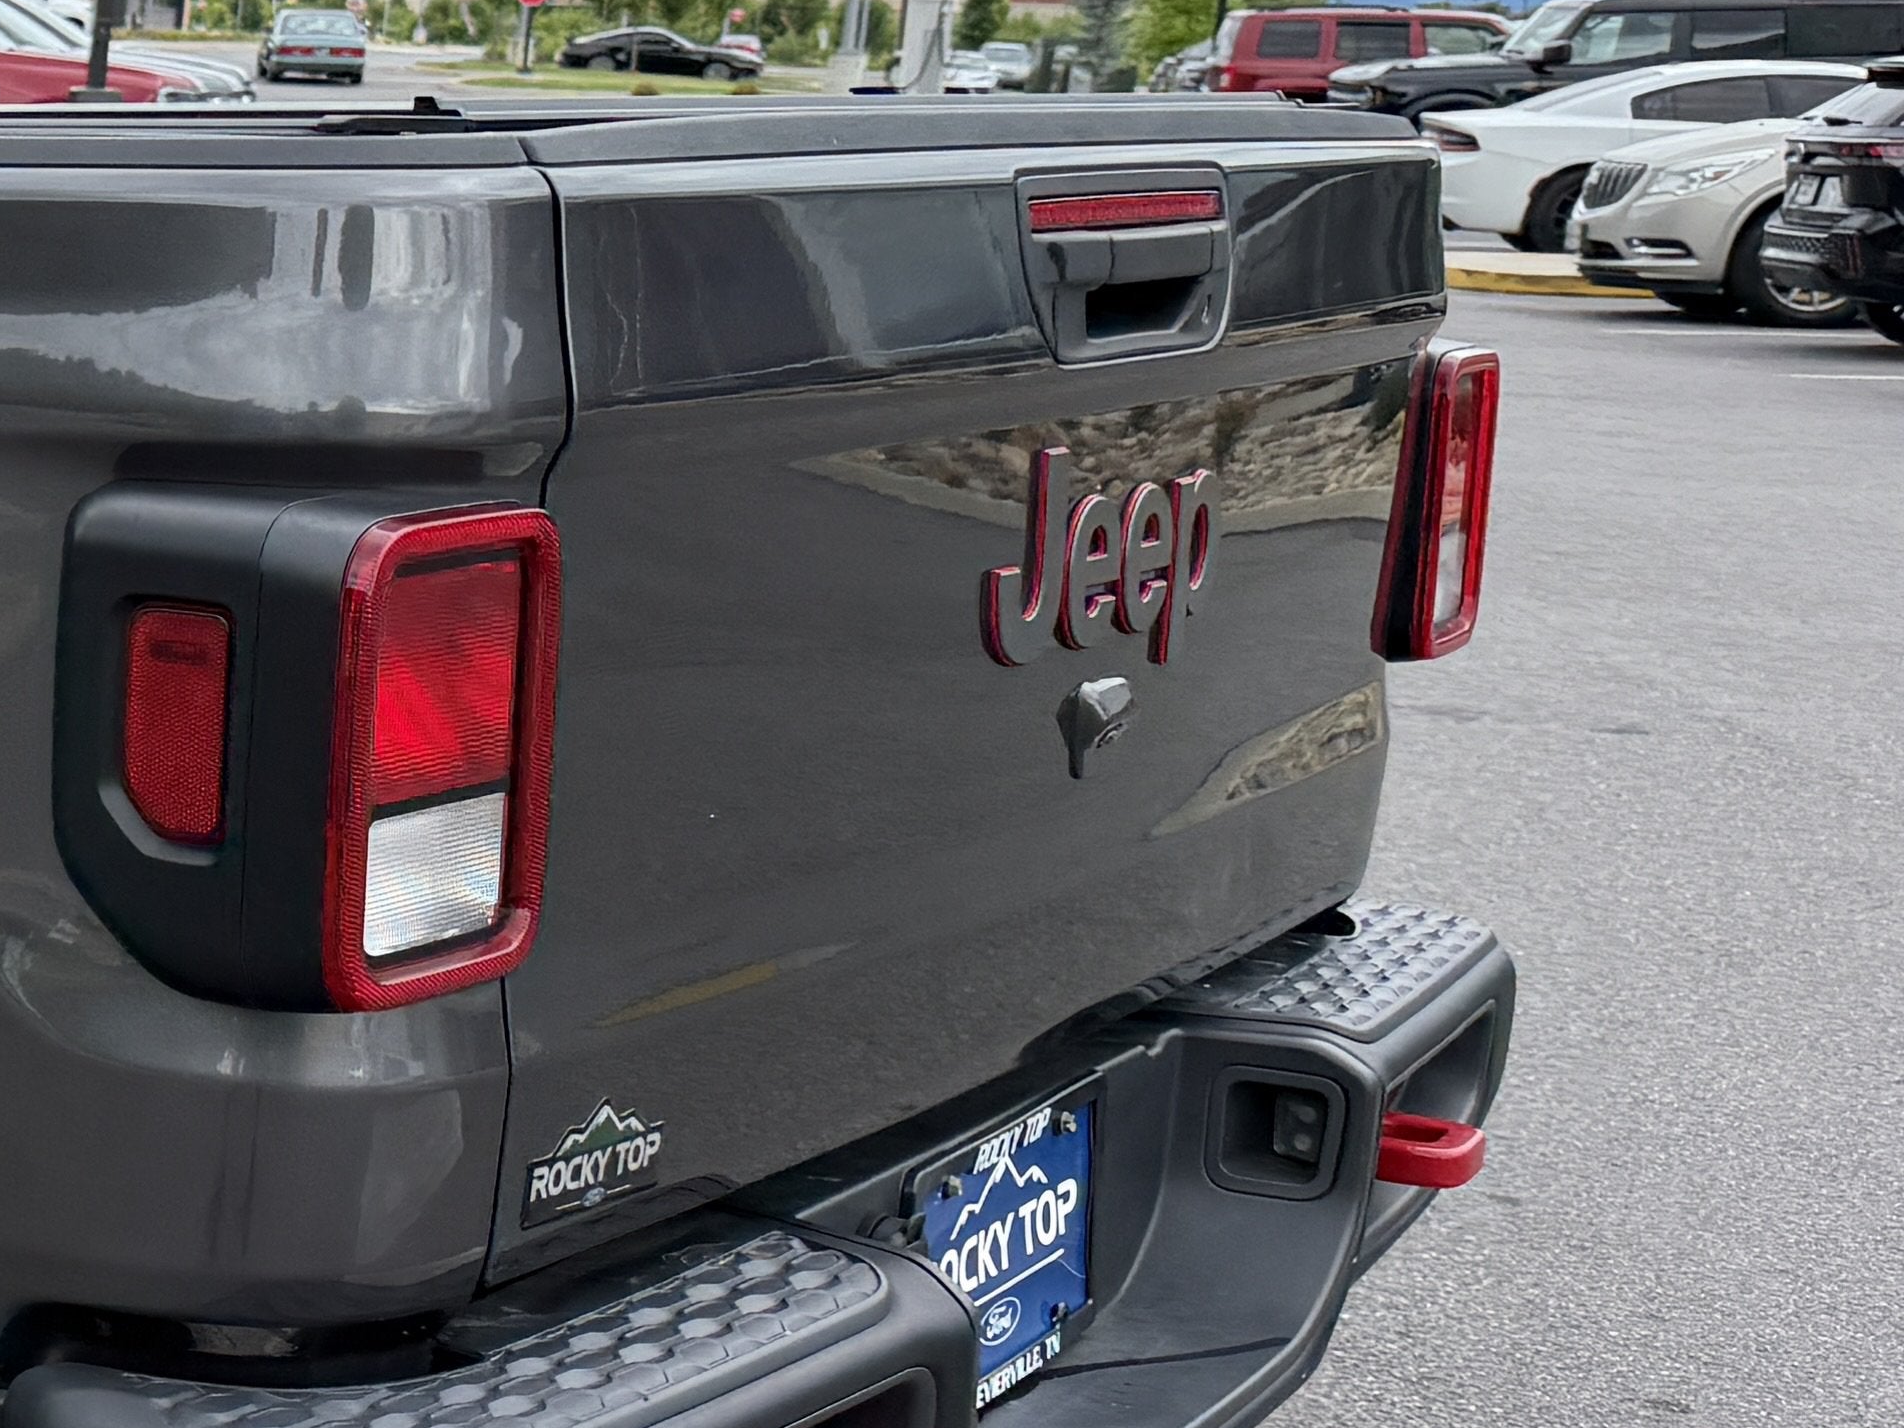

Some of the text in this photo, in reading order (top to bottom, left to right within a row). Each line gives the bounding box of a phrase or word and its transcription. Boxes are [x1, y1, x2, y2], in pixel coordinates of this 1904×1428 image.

[979, 446, 1221, 667] Jeep
[530, 1145, 613, 1202] ROCKY
[616, 1132, 662, 1176] TOP
[973, 1107, 1052, 1175] ROCKY TOP
[933, 1178, 1078, 1293] OCKY TOP
